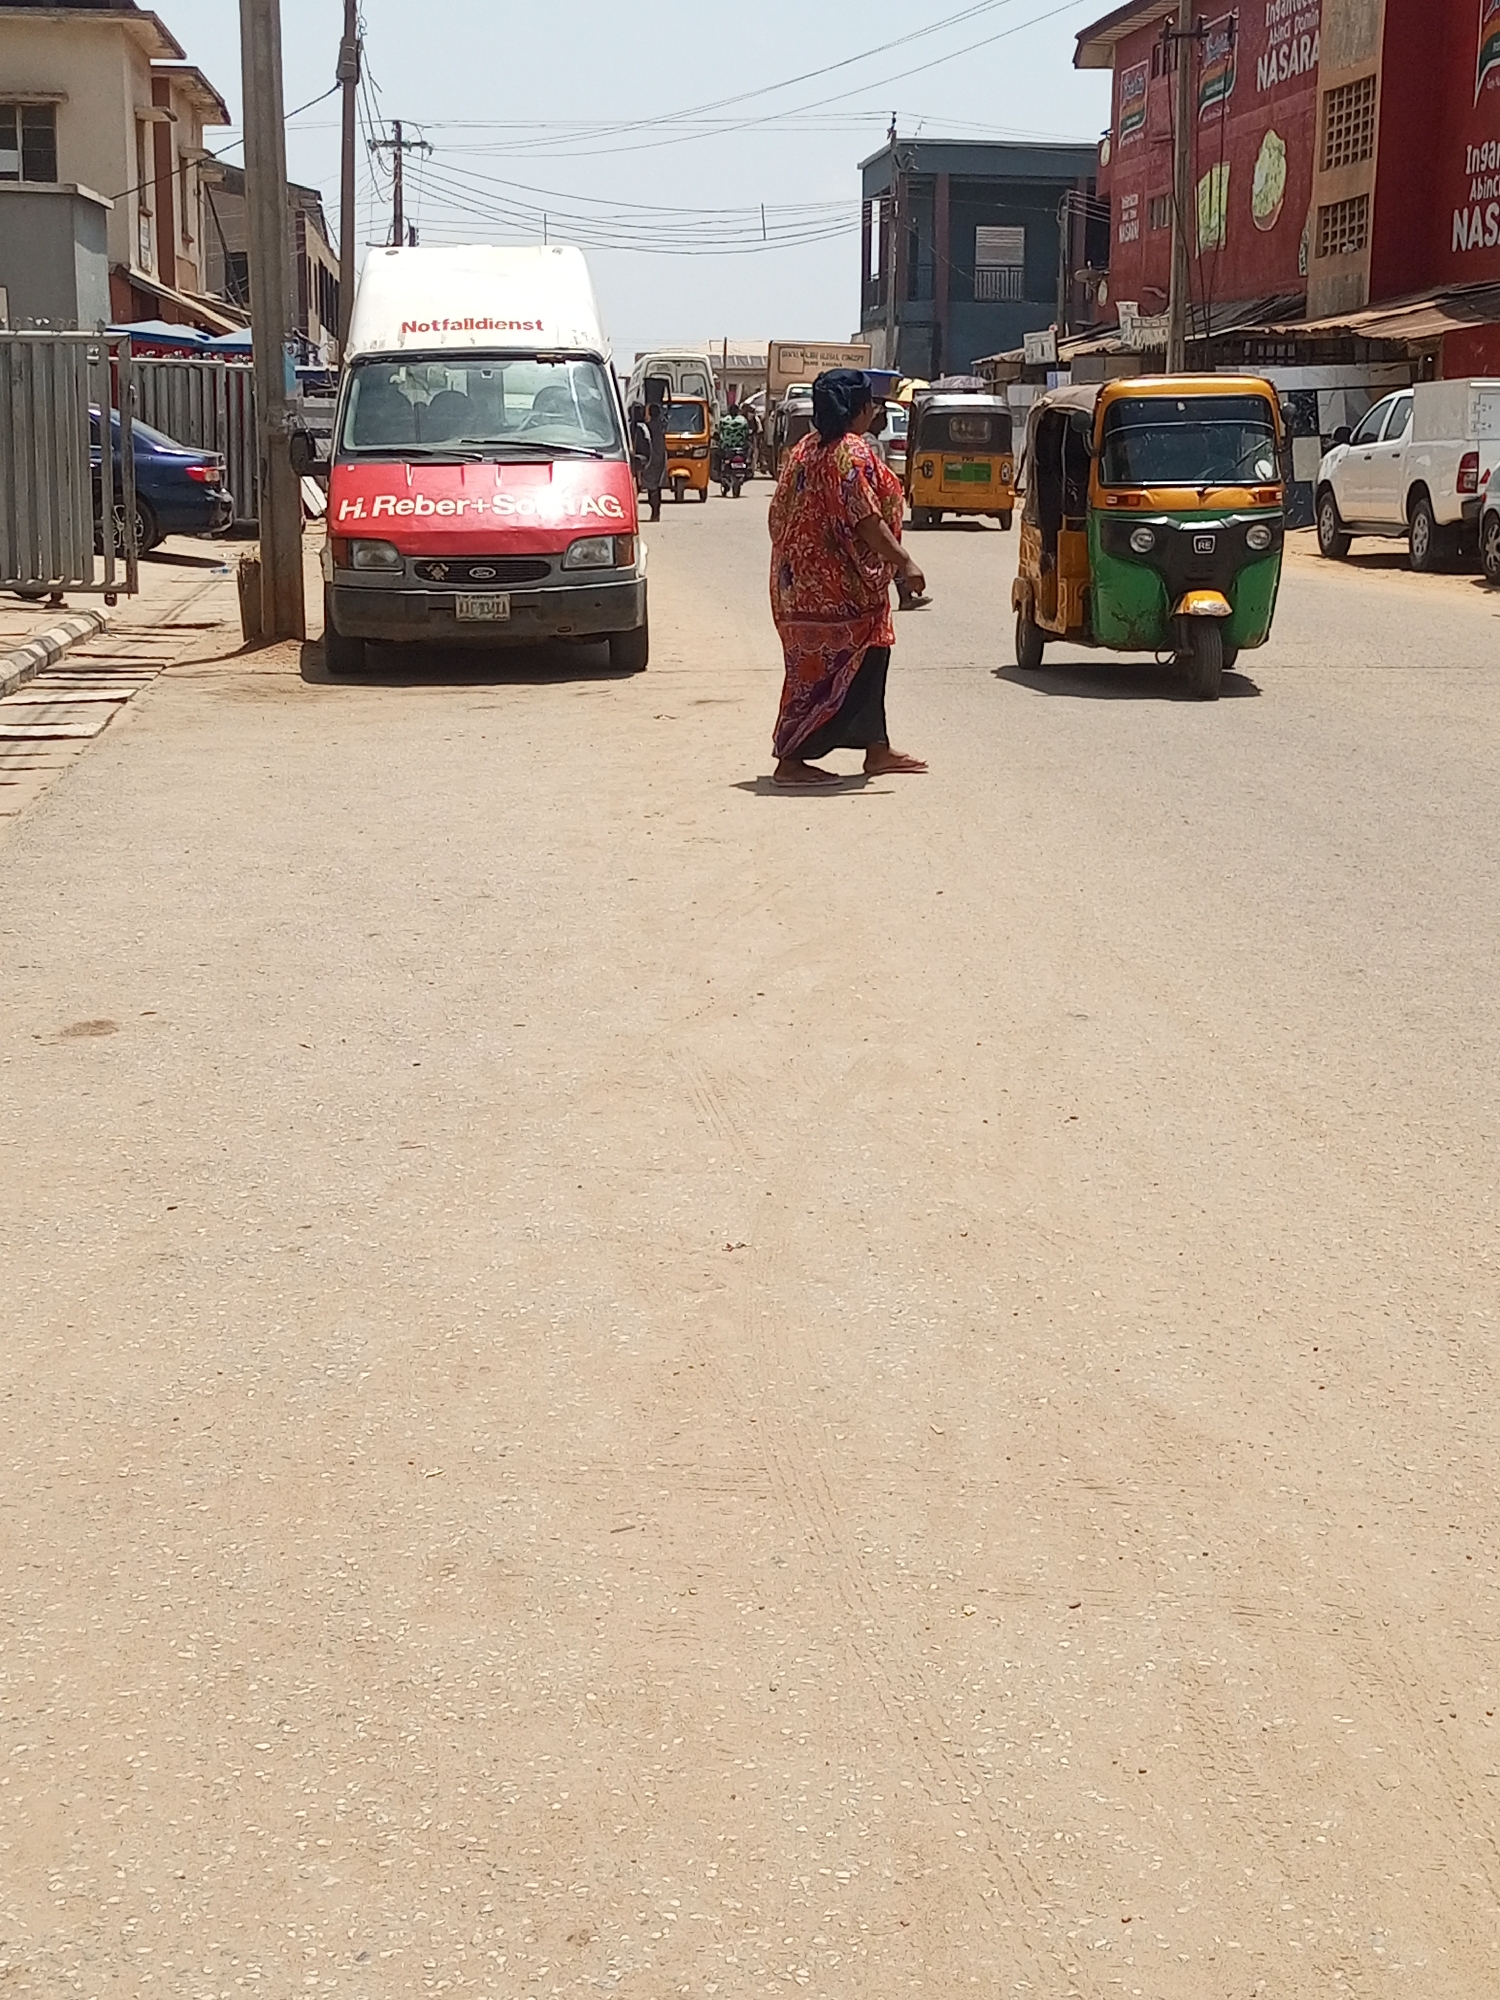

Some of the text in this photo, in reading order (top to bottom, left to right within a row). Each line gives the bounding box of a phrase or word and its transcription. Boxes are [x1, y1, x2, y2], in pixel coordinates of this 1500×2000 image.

[1257, 30, 1319, 93] NASARA
[1451, 202, 1500, 252] NAS
[401, 317, 544, 334] Notfalldienst
[338, 497, 367, 521] H.
[579, 494, 624, 519] AG
